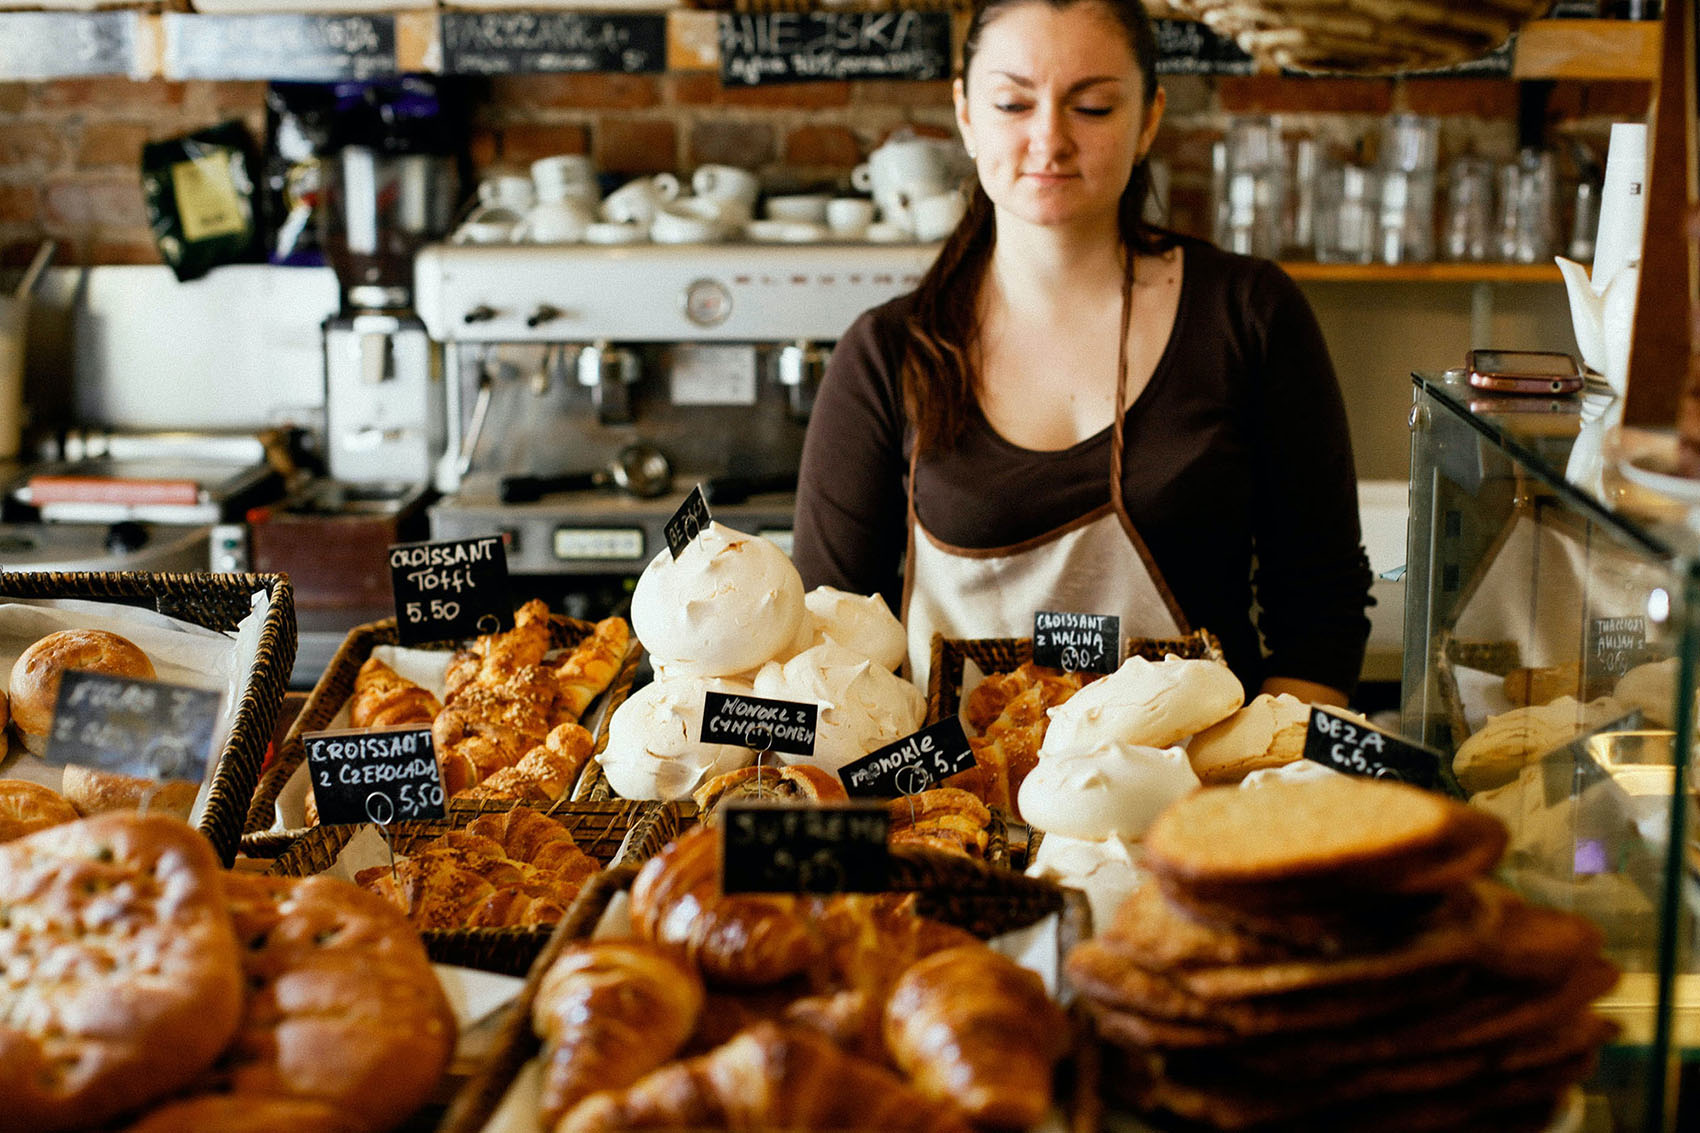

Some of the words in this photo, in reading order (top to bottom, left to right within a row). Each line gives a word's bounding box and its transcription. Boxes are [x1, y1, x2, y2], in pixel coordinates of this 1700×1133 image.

[391, 539, 497, 568] CROISSANT
[407, 564, 475, 593] Toffi
[406, 600, 460, 623] 5.50
[1037, 614, 1108, 631] CROISSANT
[721, 697, 790, 722] MONOKL
[310, 731, 432, 762] CROISSANT
[400, 782, 444, 817] 5,50
